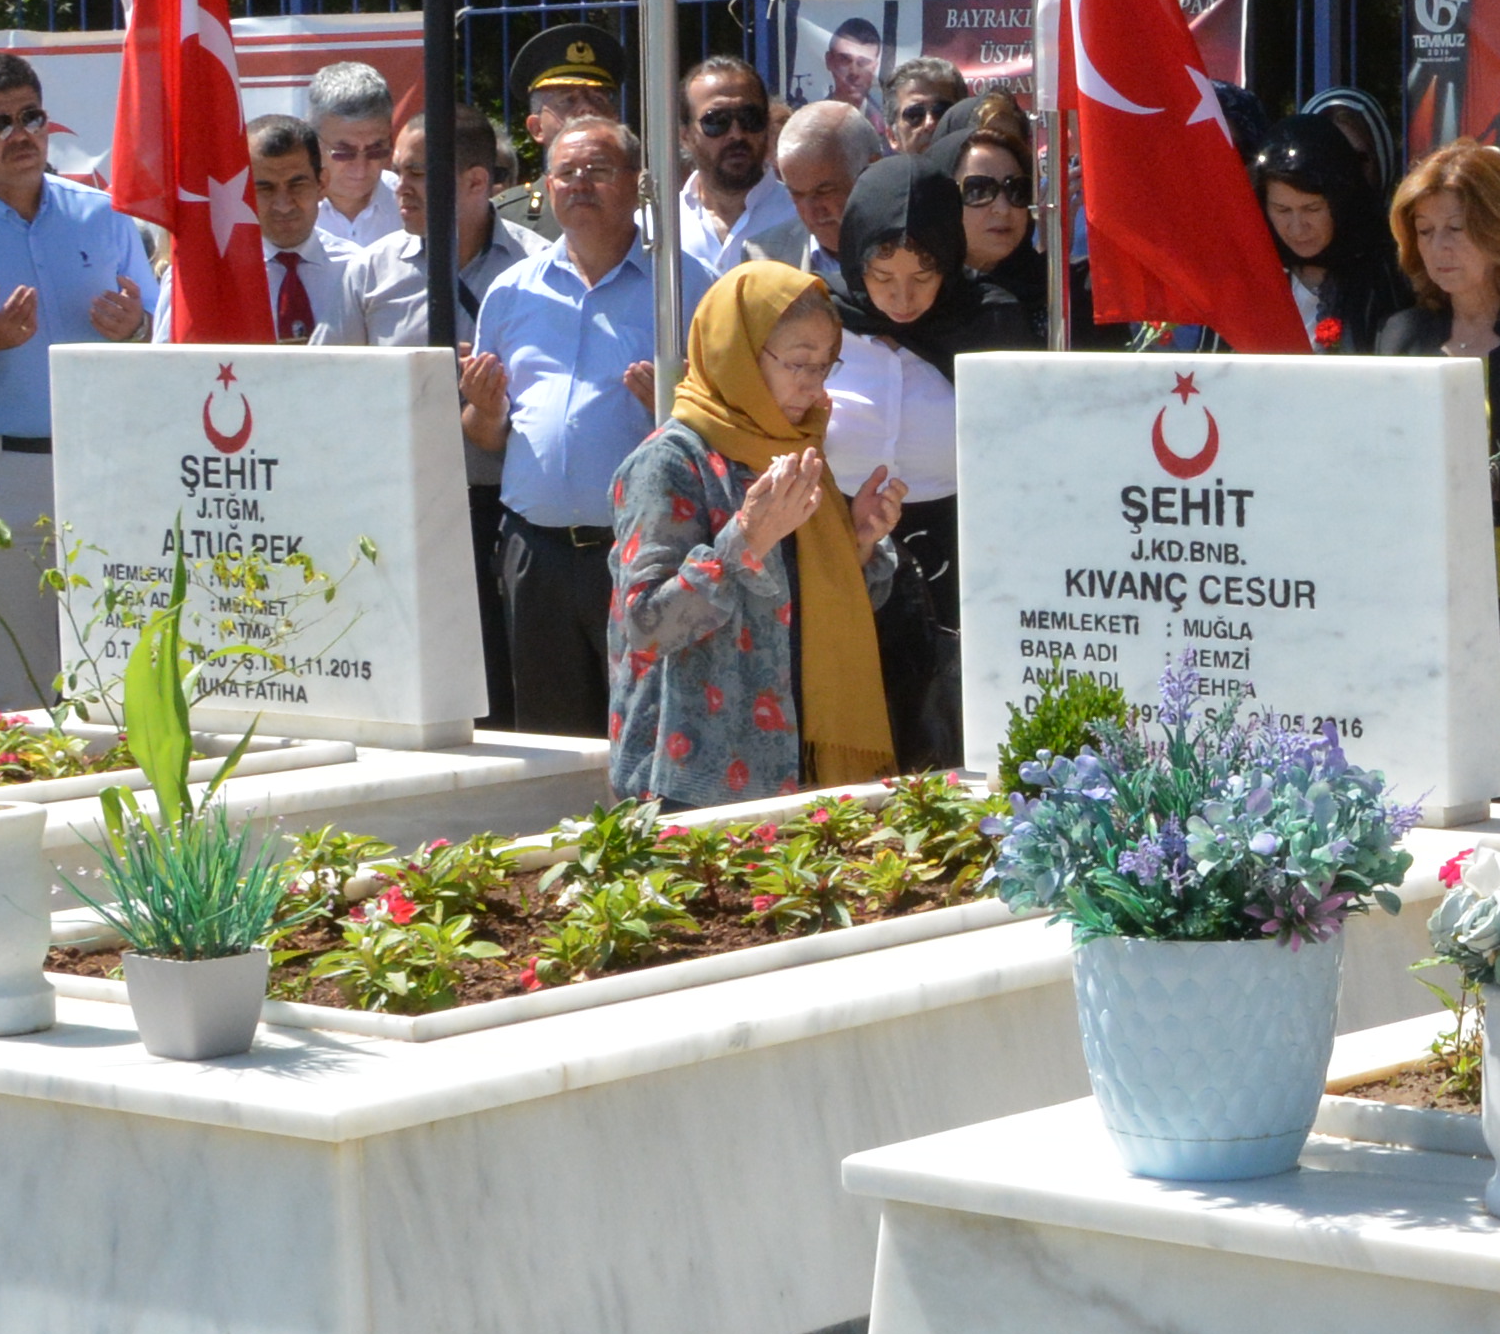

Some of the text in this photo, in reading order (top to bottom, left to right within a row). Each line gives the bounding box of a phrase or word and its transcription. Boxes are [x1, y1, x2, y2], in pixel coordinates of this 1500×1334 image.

[979, 40, 1033, 64] ÜSTÜ
[1412, 33, 1466, 49] TEMMUZ
[180, 449, 279, 497] ŞEHİT
[1120, 478, 1255, 535] ŞEHİT
[162, 523, 303, 564] ALTUĞ PEK
[1130, 538, 1248, 567] J.KD.BNB.
[1064, 568, 1317, 613] KIVANÇ CESUR
[150, 592, 171, 609] AD
[218, 596, 288, 617] MEHMET
[1183, 615, 1255, 642] MUĞLA
[1020, 639, 1077, 662] BABA
[1083, 643, 1118, 663] ADI
[244, 679, 309, 704] FATİHA
[1187, 675, 1257, 699] EHRA
